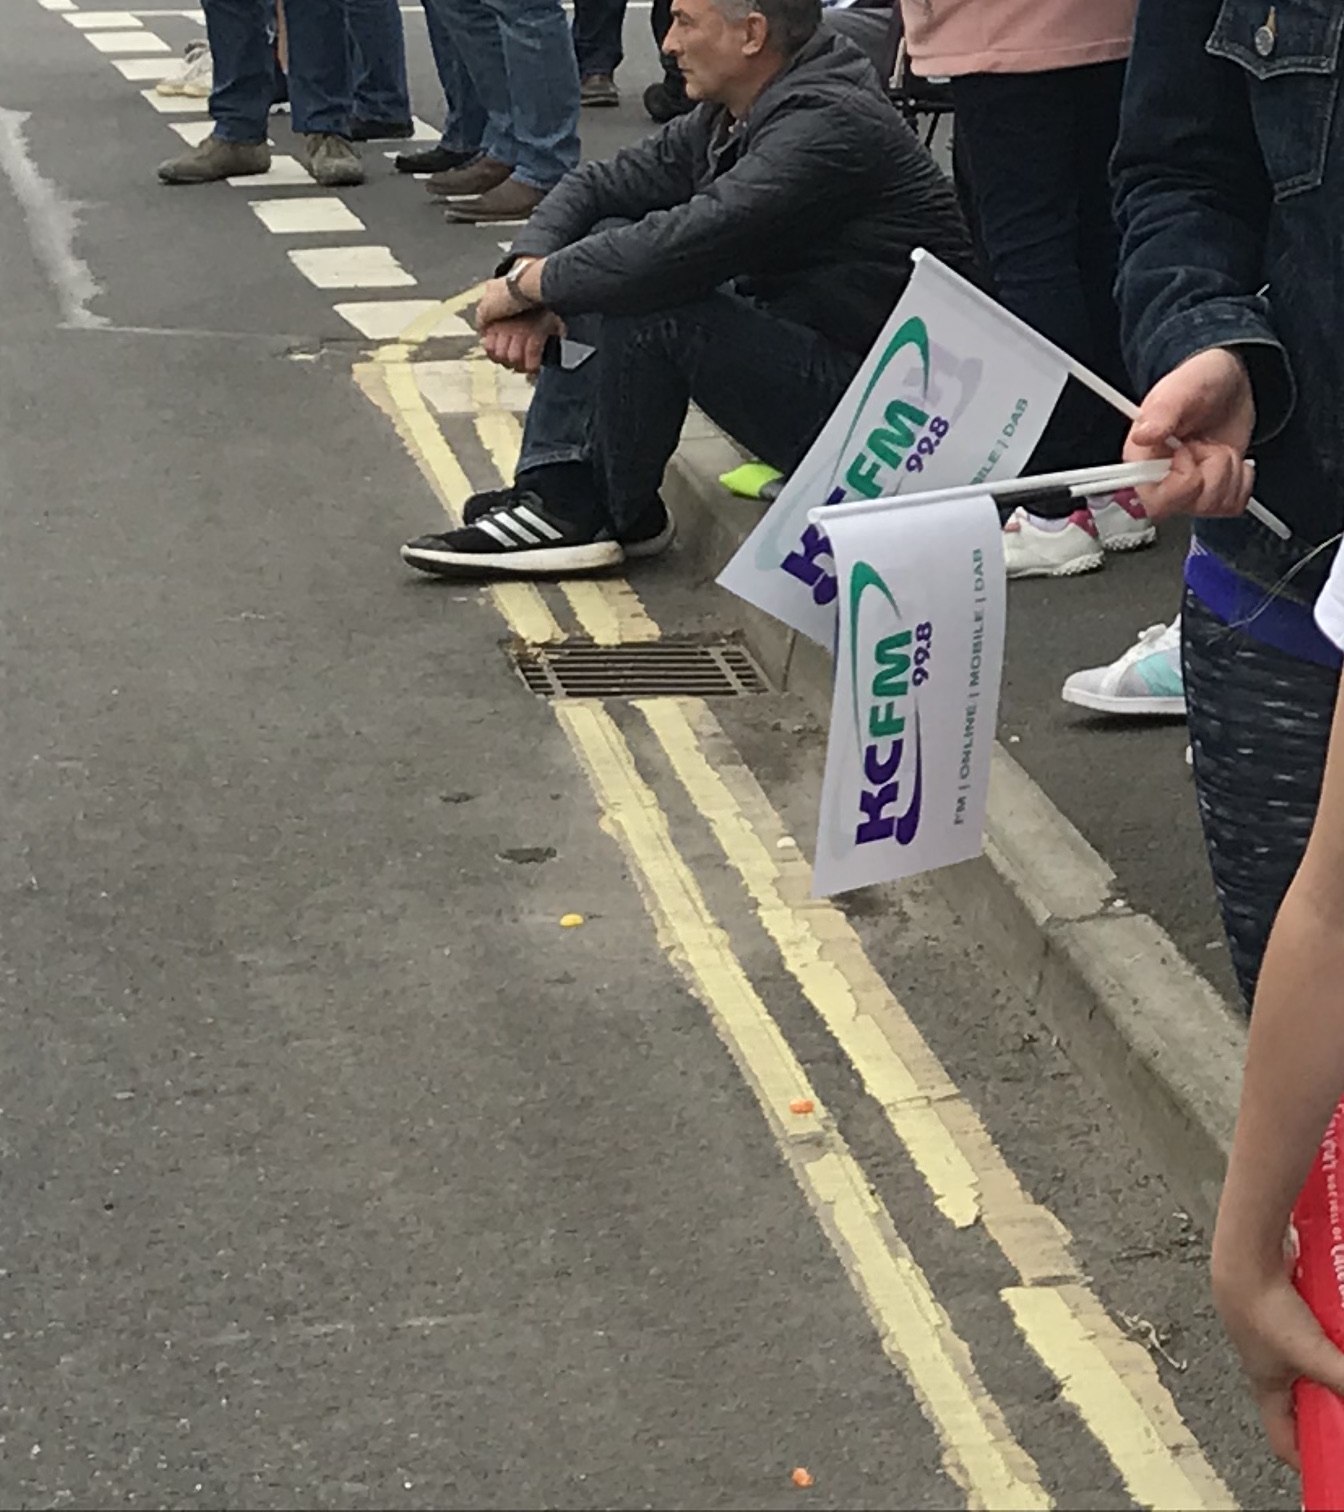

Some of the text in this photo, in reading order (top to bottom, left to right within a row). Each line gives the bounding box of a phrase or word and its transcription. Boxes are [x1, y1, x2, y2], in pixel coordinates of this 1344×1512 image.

[905, 416, 949, 473] 99.8
[1003, 399, 1028, 437] DAB
[780, 399, 930, 587] KFM
[912, 621, 934, 687] 99.8
[954, 547, 986, 826] FM ONLINE MOBILE DAB
[855, 629, 913, 846] KCFM
